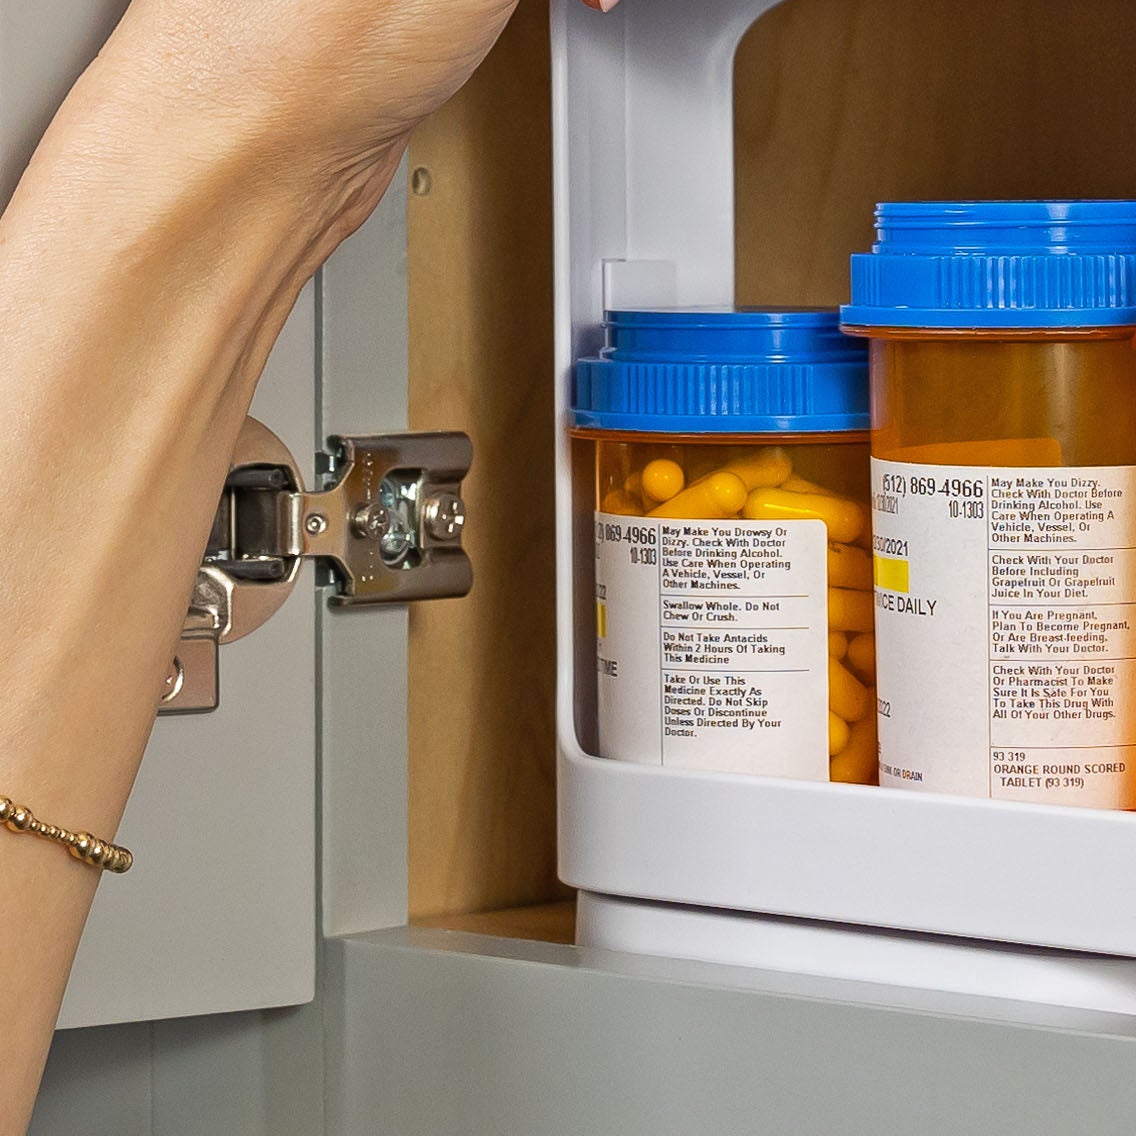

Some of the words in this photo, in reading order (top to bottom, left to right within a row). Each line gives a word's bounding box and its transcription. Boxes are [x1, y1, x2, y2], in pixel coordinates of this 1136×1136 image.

[883, 474, 906, 497] (512)
[910, 477, 983, 497] 869-4966
[992, 478, 1012, 489] May
[1016, 478, 1044, 487] Make
[1047, 479, 1067, 487] You
[1071, 479, 1100, 489] Dizzy.
[992, 489, 1023, 498] Check
[1026, 490, 1050, 498] With
[1055, 489, 1087, 498] Doctor
[1092, 489, 1122, 498] Before
[949, 500, 984, 519] 10-1303
[992, 500, 1035, 511] Drinking
[1039, 500, 1082, 509] Alcohol.
[1086, 500, 1102, 509] Use
[992, 512, 1016, 520] Care
[1019, 512, 1049, 520] When
[1054, 511, 1104, 522] Operating
[1107, 511, 1114, 519] A
[630, 547, 656, 565] 10-1303
[992, 566, 1026, 576] Before
[1030, 566, 1079, 577] Including
[992, 577, 1045, 588] Grapefruit
[1049, 578, 1060, 587] Or
[1065, 577, 1115, 588] Grapefruit
[992, 589, 1020, 598] Juice
[1024, 589, 1033, 598] In
[1037, 589, 1060, 598] Your
[1065, 589, 1088, 598] Diet.
[664, 600, 702, 610] Swallow
[706, 602, 741, 611] Whole.
[746, 602, 758, 611] Do
[762, 602, 780, 610] Not
[898, 597, 936, 615] DAILY
[664, 612, 688, 620] Chew
[692, 612, 703, 621] Or
[706, 612, 738, 622] Crush.
[664, 632, 675, 641] Do
[678, 633, 694, 642] Not
[698, 633, 720, 642] Take
[724, 634, 768, 643] Antacids
[664, 643, 693, 652] Within
[705, 645, 733, 654] Hours
[736, 646, 748, 654] Of
[752, 645, 785, 655] Taking
[664, 653, 682, 662] This
[685, 654, 729, 664] Medicine
[993, 752, 1004, 761] 93
[1008, 752, 1025, 762] 319
[994, 765, 1038, 774] ORANGE
[1043, 765, 1080, 774] ROUND
[1085, 763, 1126, 773] SCORED
[902, 770, 922, 781] DRAIN
[1000, 777, 1042, 787] TABLET
[1045, 778, 1060, 789] (93
[1064, 778, 1084, 789] 319)
